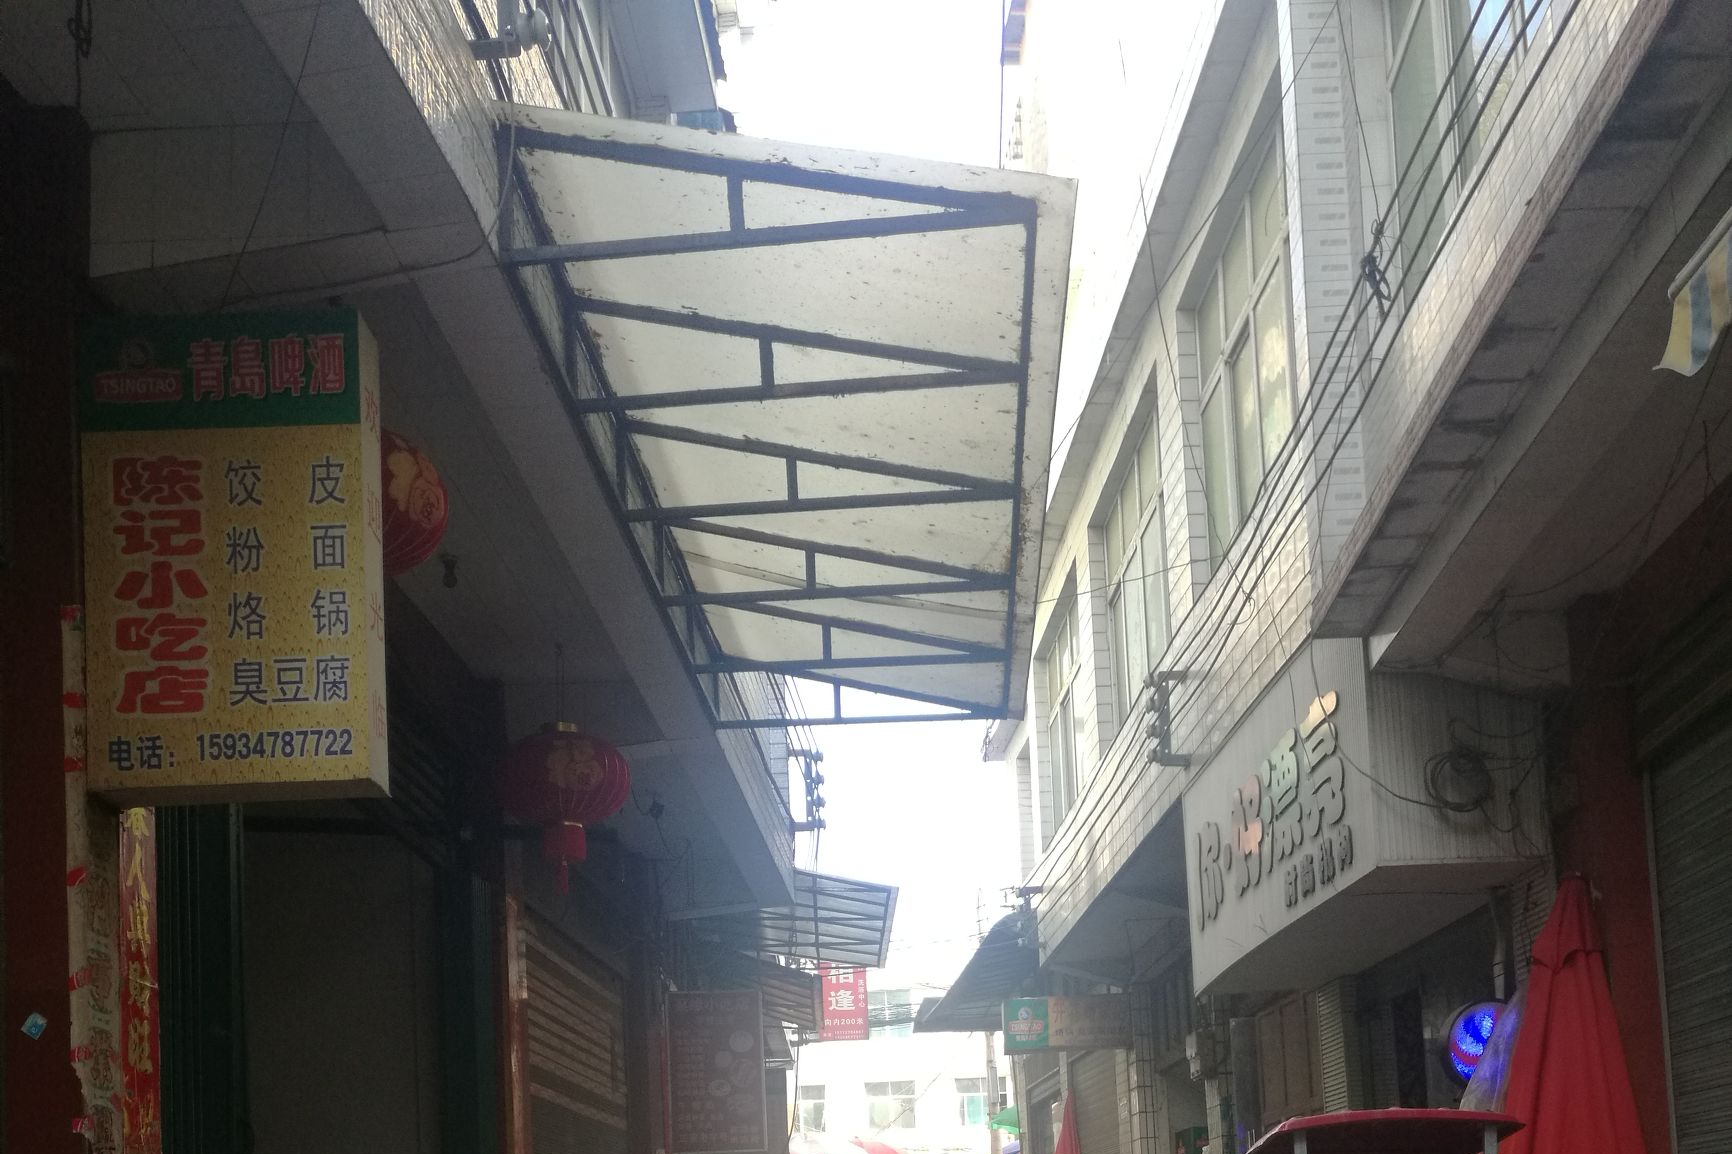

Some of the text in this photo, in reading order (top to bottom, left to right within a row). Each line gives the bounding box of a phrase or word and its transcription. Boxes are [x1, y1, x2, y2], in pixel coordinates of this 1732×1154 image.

[99, 375, 178, 394] TSINGTAO
[112, 455, 209, 716] 陈记小吃店
[229, 655, 351, 706] 臭豆腐
